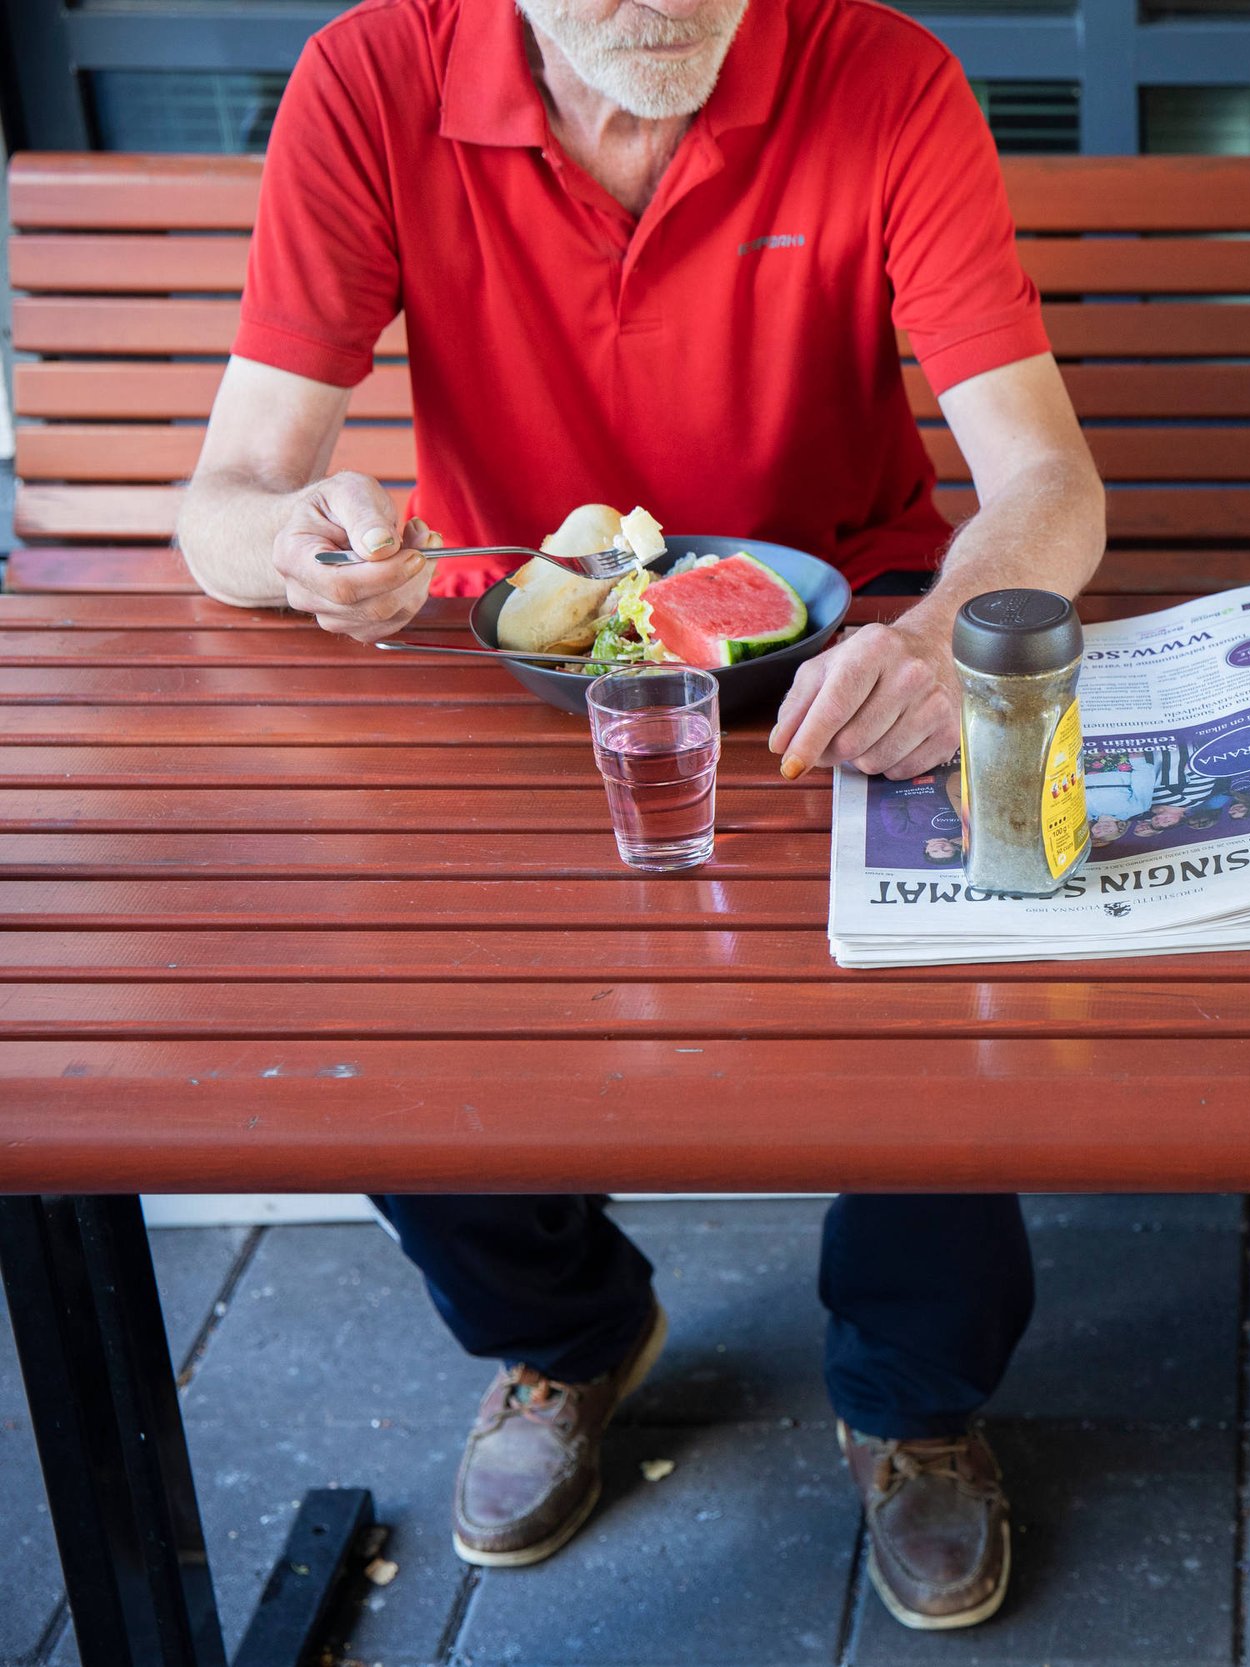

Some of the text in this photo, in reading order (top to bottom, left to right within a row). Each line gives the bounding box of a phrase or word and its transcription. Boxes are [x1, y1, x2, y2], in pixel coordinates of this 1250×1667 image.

[1086, 631, 1213, 662] www.se
[1208, 632, 1248, 650] Tutustu
[1217, 701, 1232, 712] on
[1167, 708, 1215, 724] Suomen
[1229, 717, 1245, 726] on
[1195, 723, 1228, 736] aikaa.
[1102, 735, 1177, 748] tehdään
[1104, 743, 1178, 755] Suomen
[870, 876, 1086, 904] SOMAT
[1052, 903, 1100, 913] VUONNA
